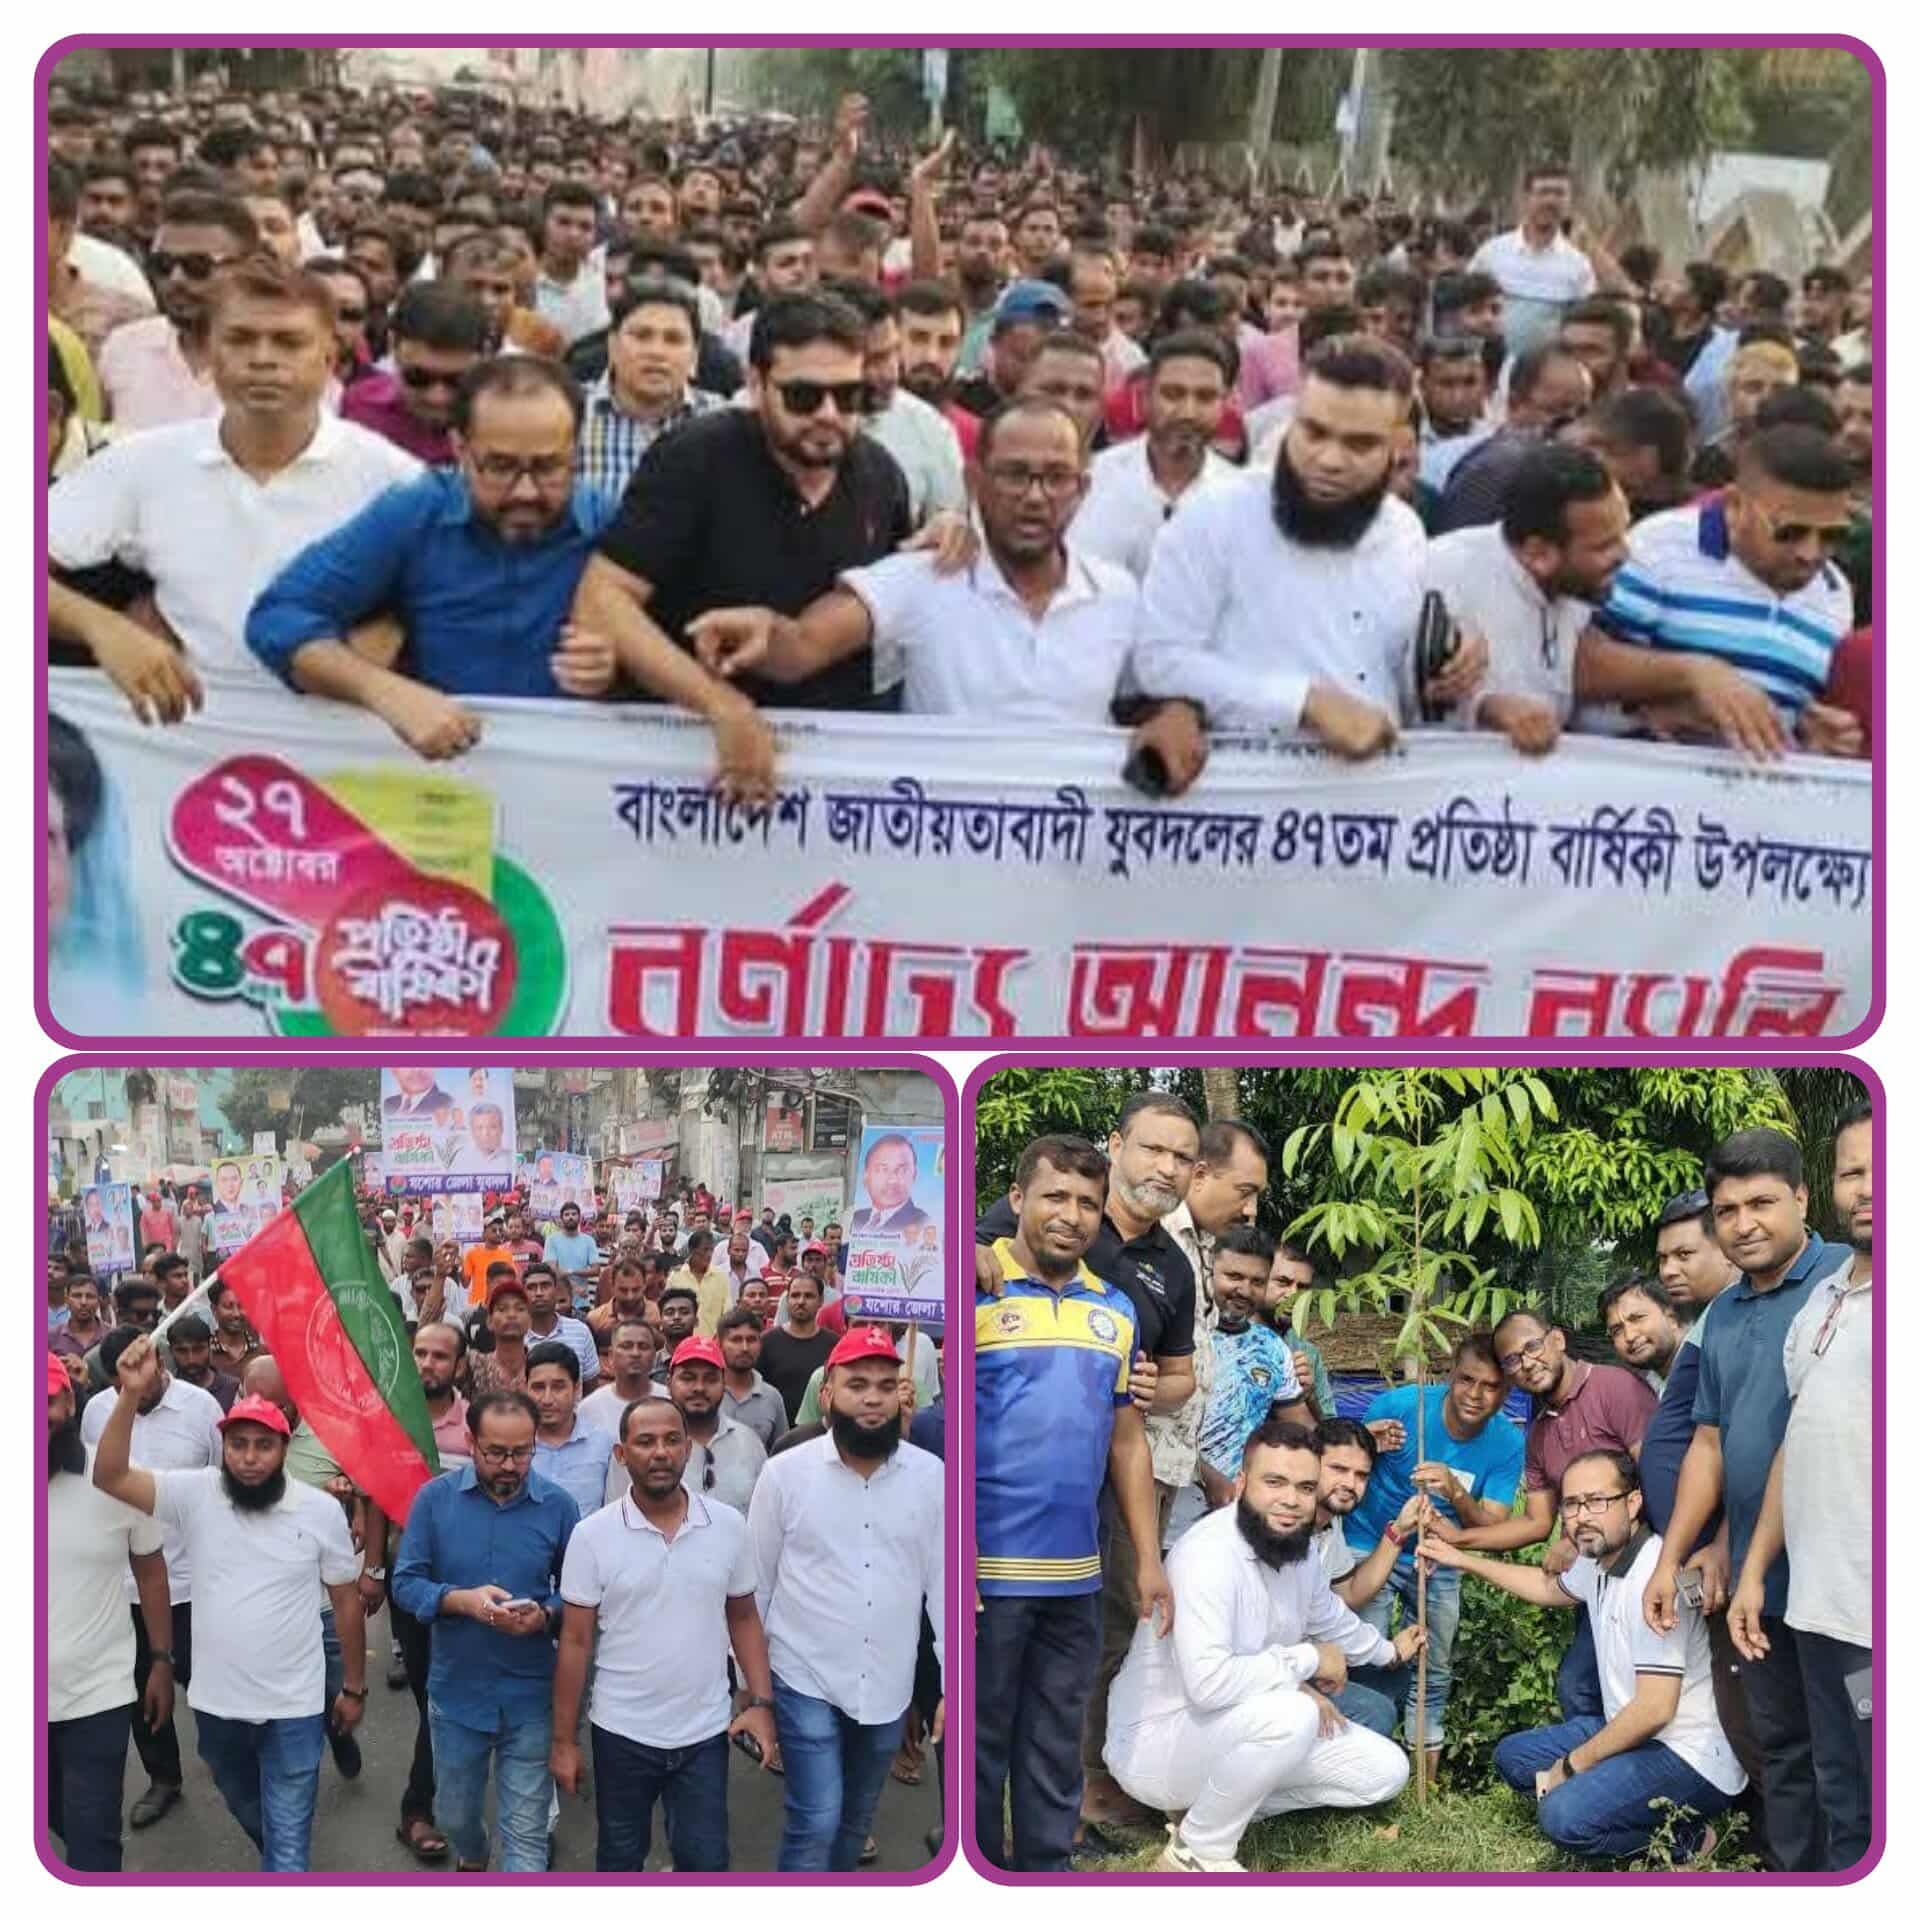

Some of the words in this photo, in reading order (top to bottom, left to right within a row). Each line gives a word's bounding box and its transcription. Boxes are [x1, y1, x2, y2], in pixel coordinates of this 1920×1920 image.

[214, 775, 307, 848] ২৭
[612, 781, 811, 848] বাংলাদেশ
[824, 776, 1094, 863] জাতীয়তাবাদী
[1104, 807, 1264, 880] যুবদলের
[1271, 808, 1400, 876] ৪৭তম
[1405, 795, 1538, 884] প্রতিষ্ঠা
[1548, 804, 1682, 895] বার্ষিকী
[1694, 813, 1872, 908] উপলক্ষ্যে
[177, 910, 306, 1001] ৪৭
